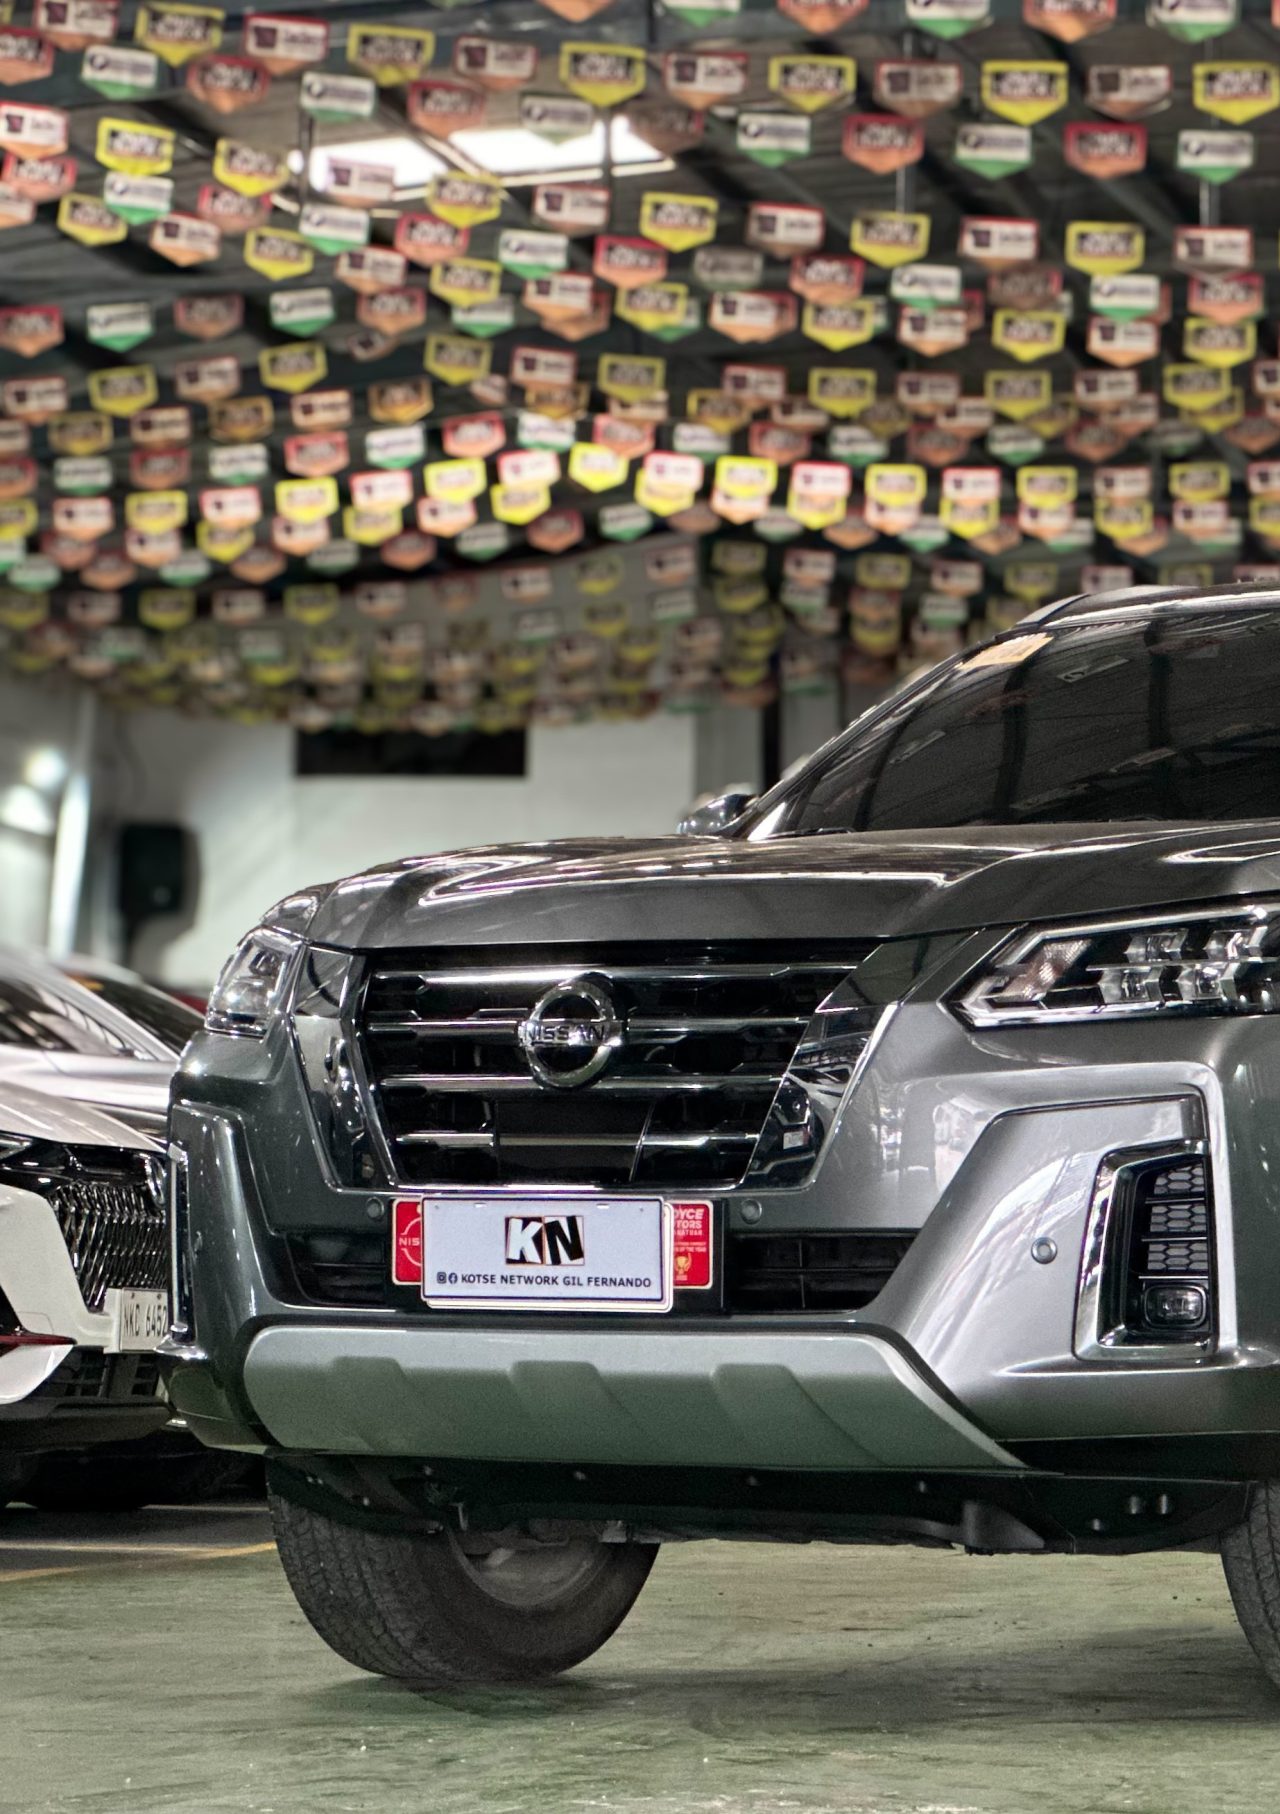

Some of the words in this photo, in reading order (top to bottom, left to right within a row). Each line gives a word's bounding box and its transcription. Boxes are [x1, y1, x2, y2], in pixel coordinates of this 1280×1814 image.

[673, 1208, 704, 1220] OYCE
[676, 1220, 702, 1229] TORS
[399, 1237, 420, 1246] NIS
[506, 1215, 585, 1265] KN
[461, 1273, 497, 1284] KOTSE
[500, 1274, 560, 1286] NETWORK
[563, 1275, 584, 1287] GIL
[587, 1276, 652, 1288] FERNANDO
